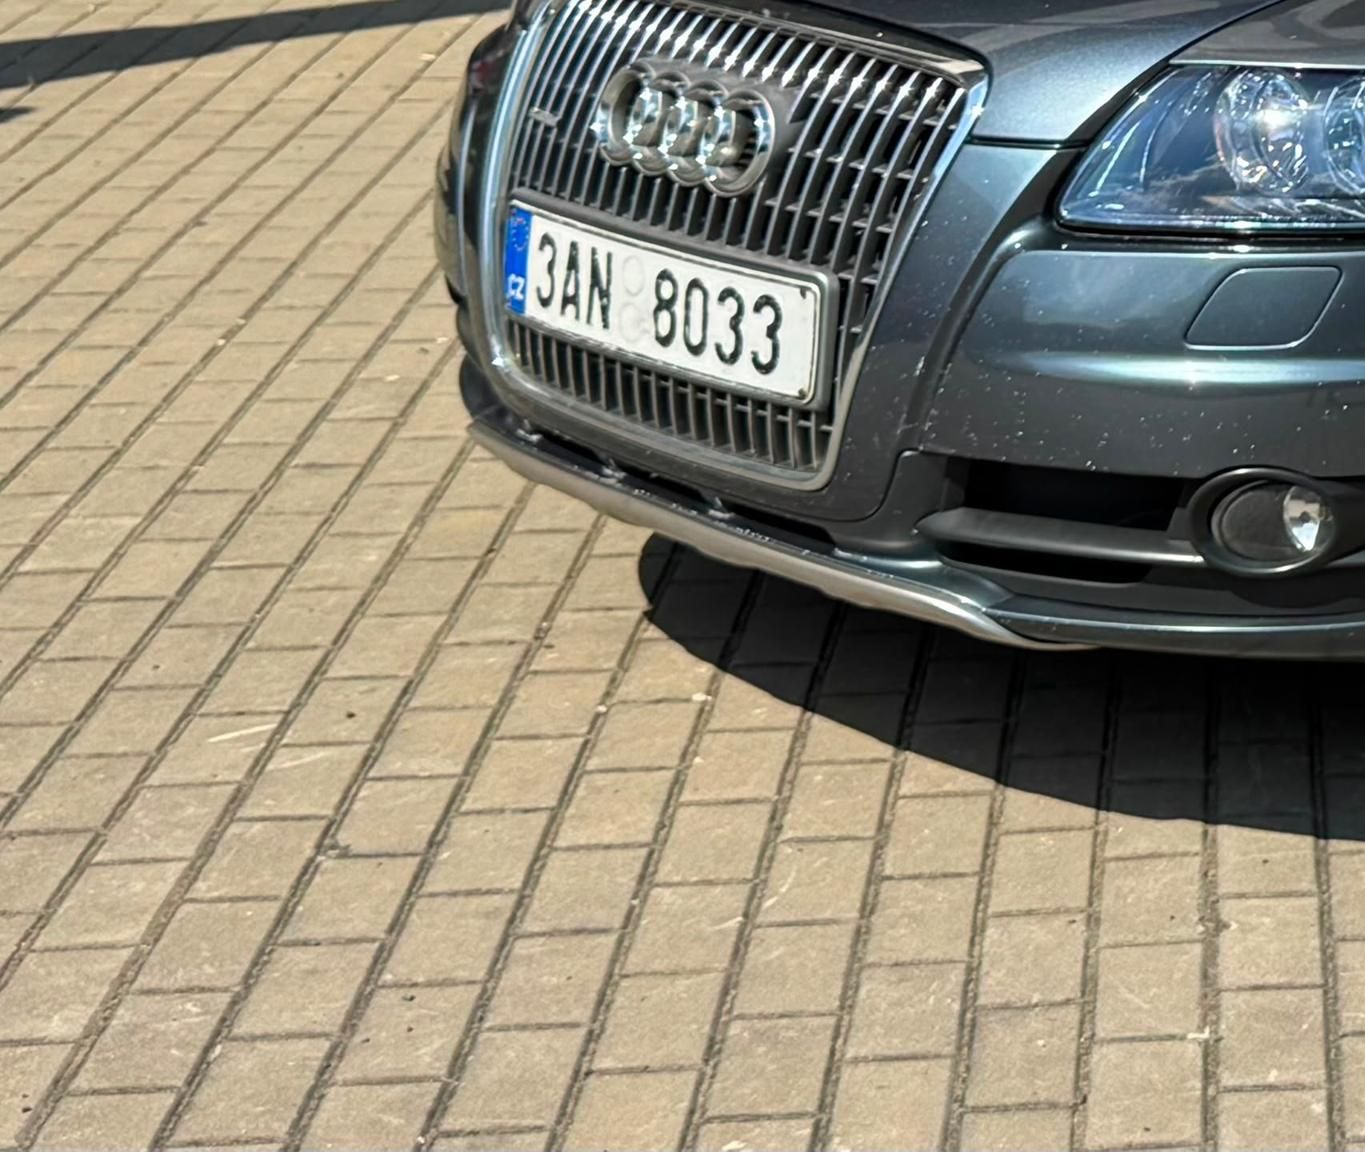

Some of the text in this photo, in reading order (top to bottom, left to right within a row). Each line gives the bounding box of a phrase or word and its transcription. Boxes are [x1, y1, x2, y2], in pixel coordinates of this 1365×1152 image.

[507, 272, 526, 301] CZ
[535, 231, 784, 375] 3AN 8033
